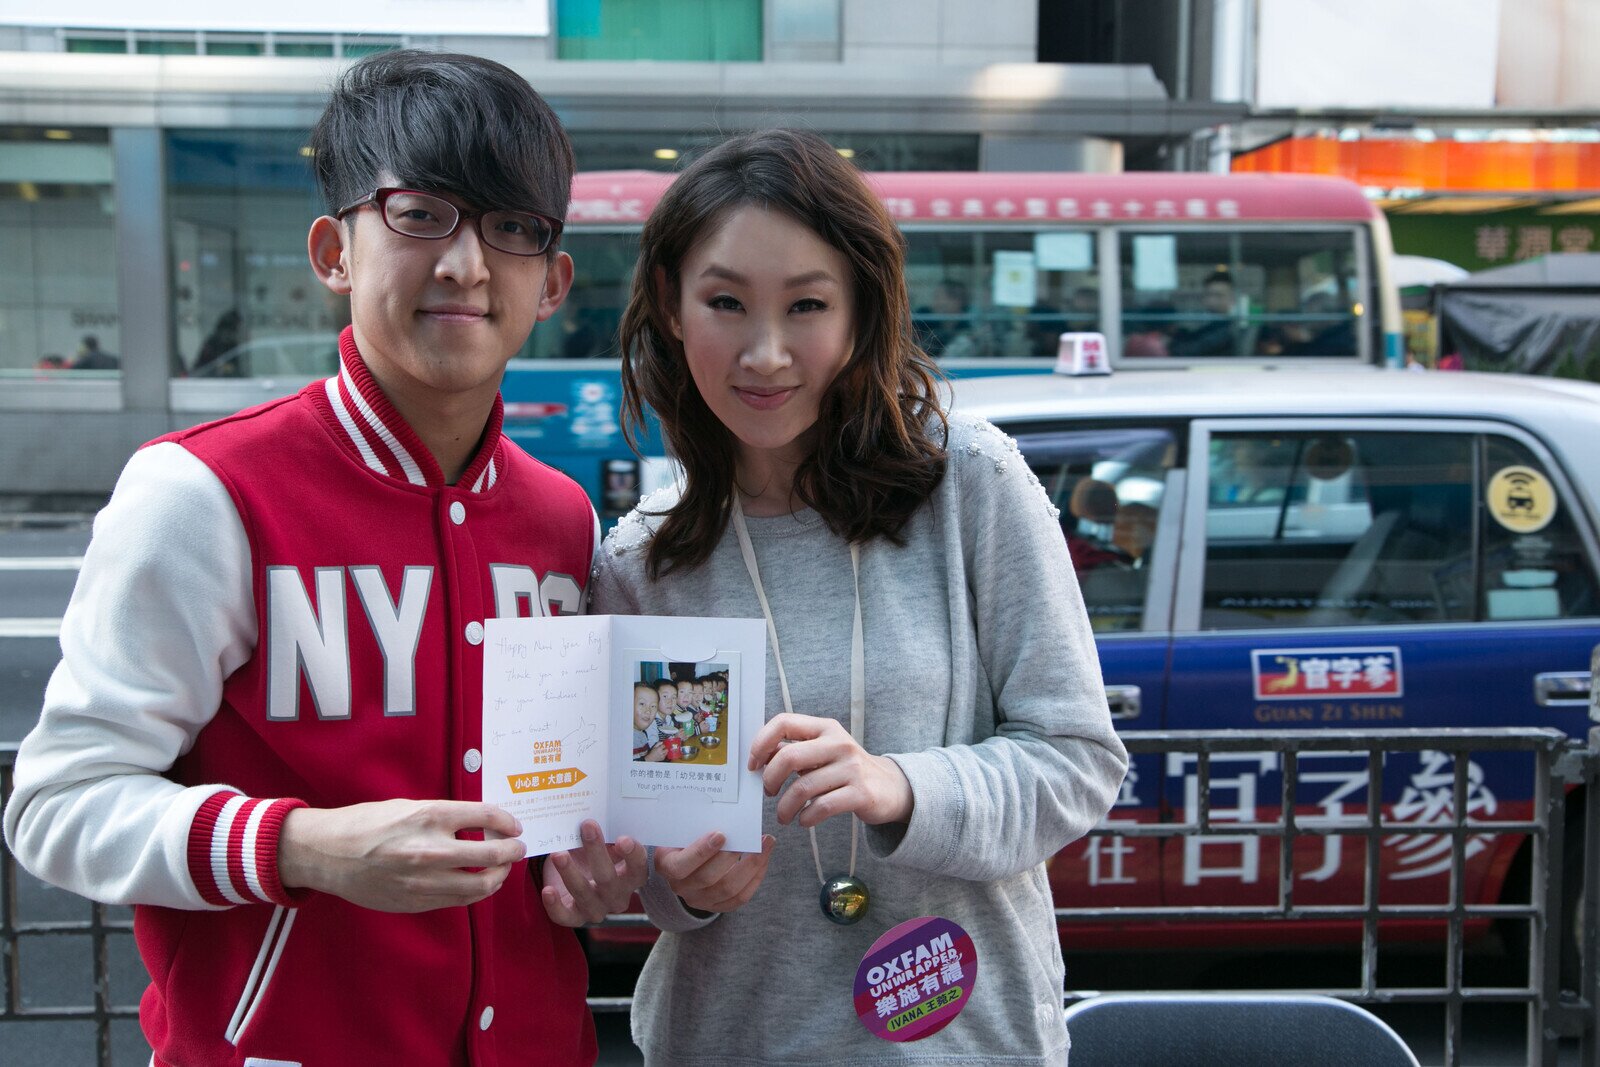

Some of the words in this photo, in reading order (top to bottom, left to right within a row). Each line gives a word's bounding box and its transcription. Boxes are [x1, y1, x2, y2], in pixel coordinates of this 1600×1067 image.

[266, 565, 434, 721] NY
[534, 739, 561, 750] OXFAM
[866, 932, 954, 985] OXFAM
[891, 1007, 924, 1031] IVANA
